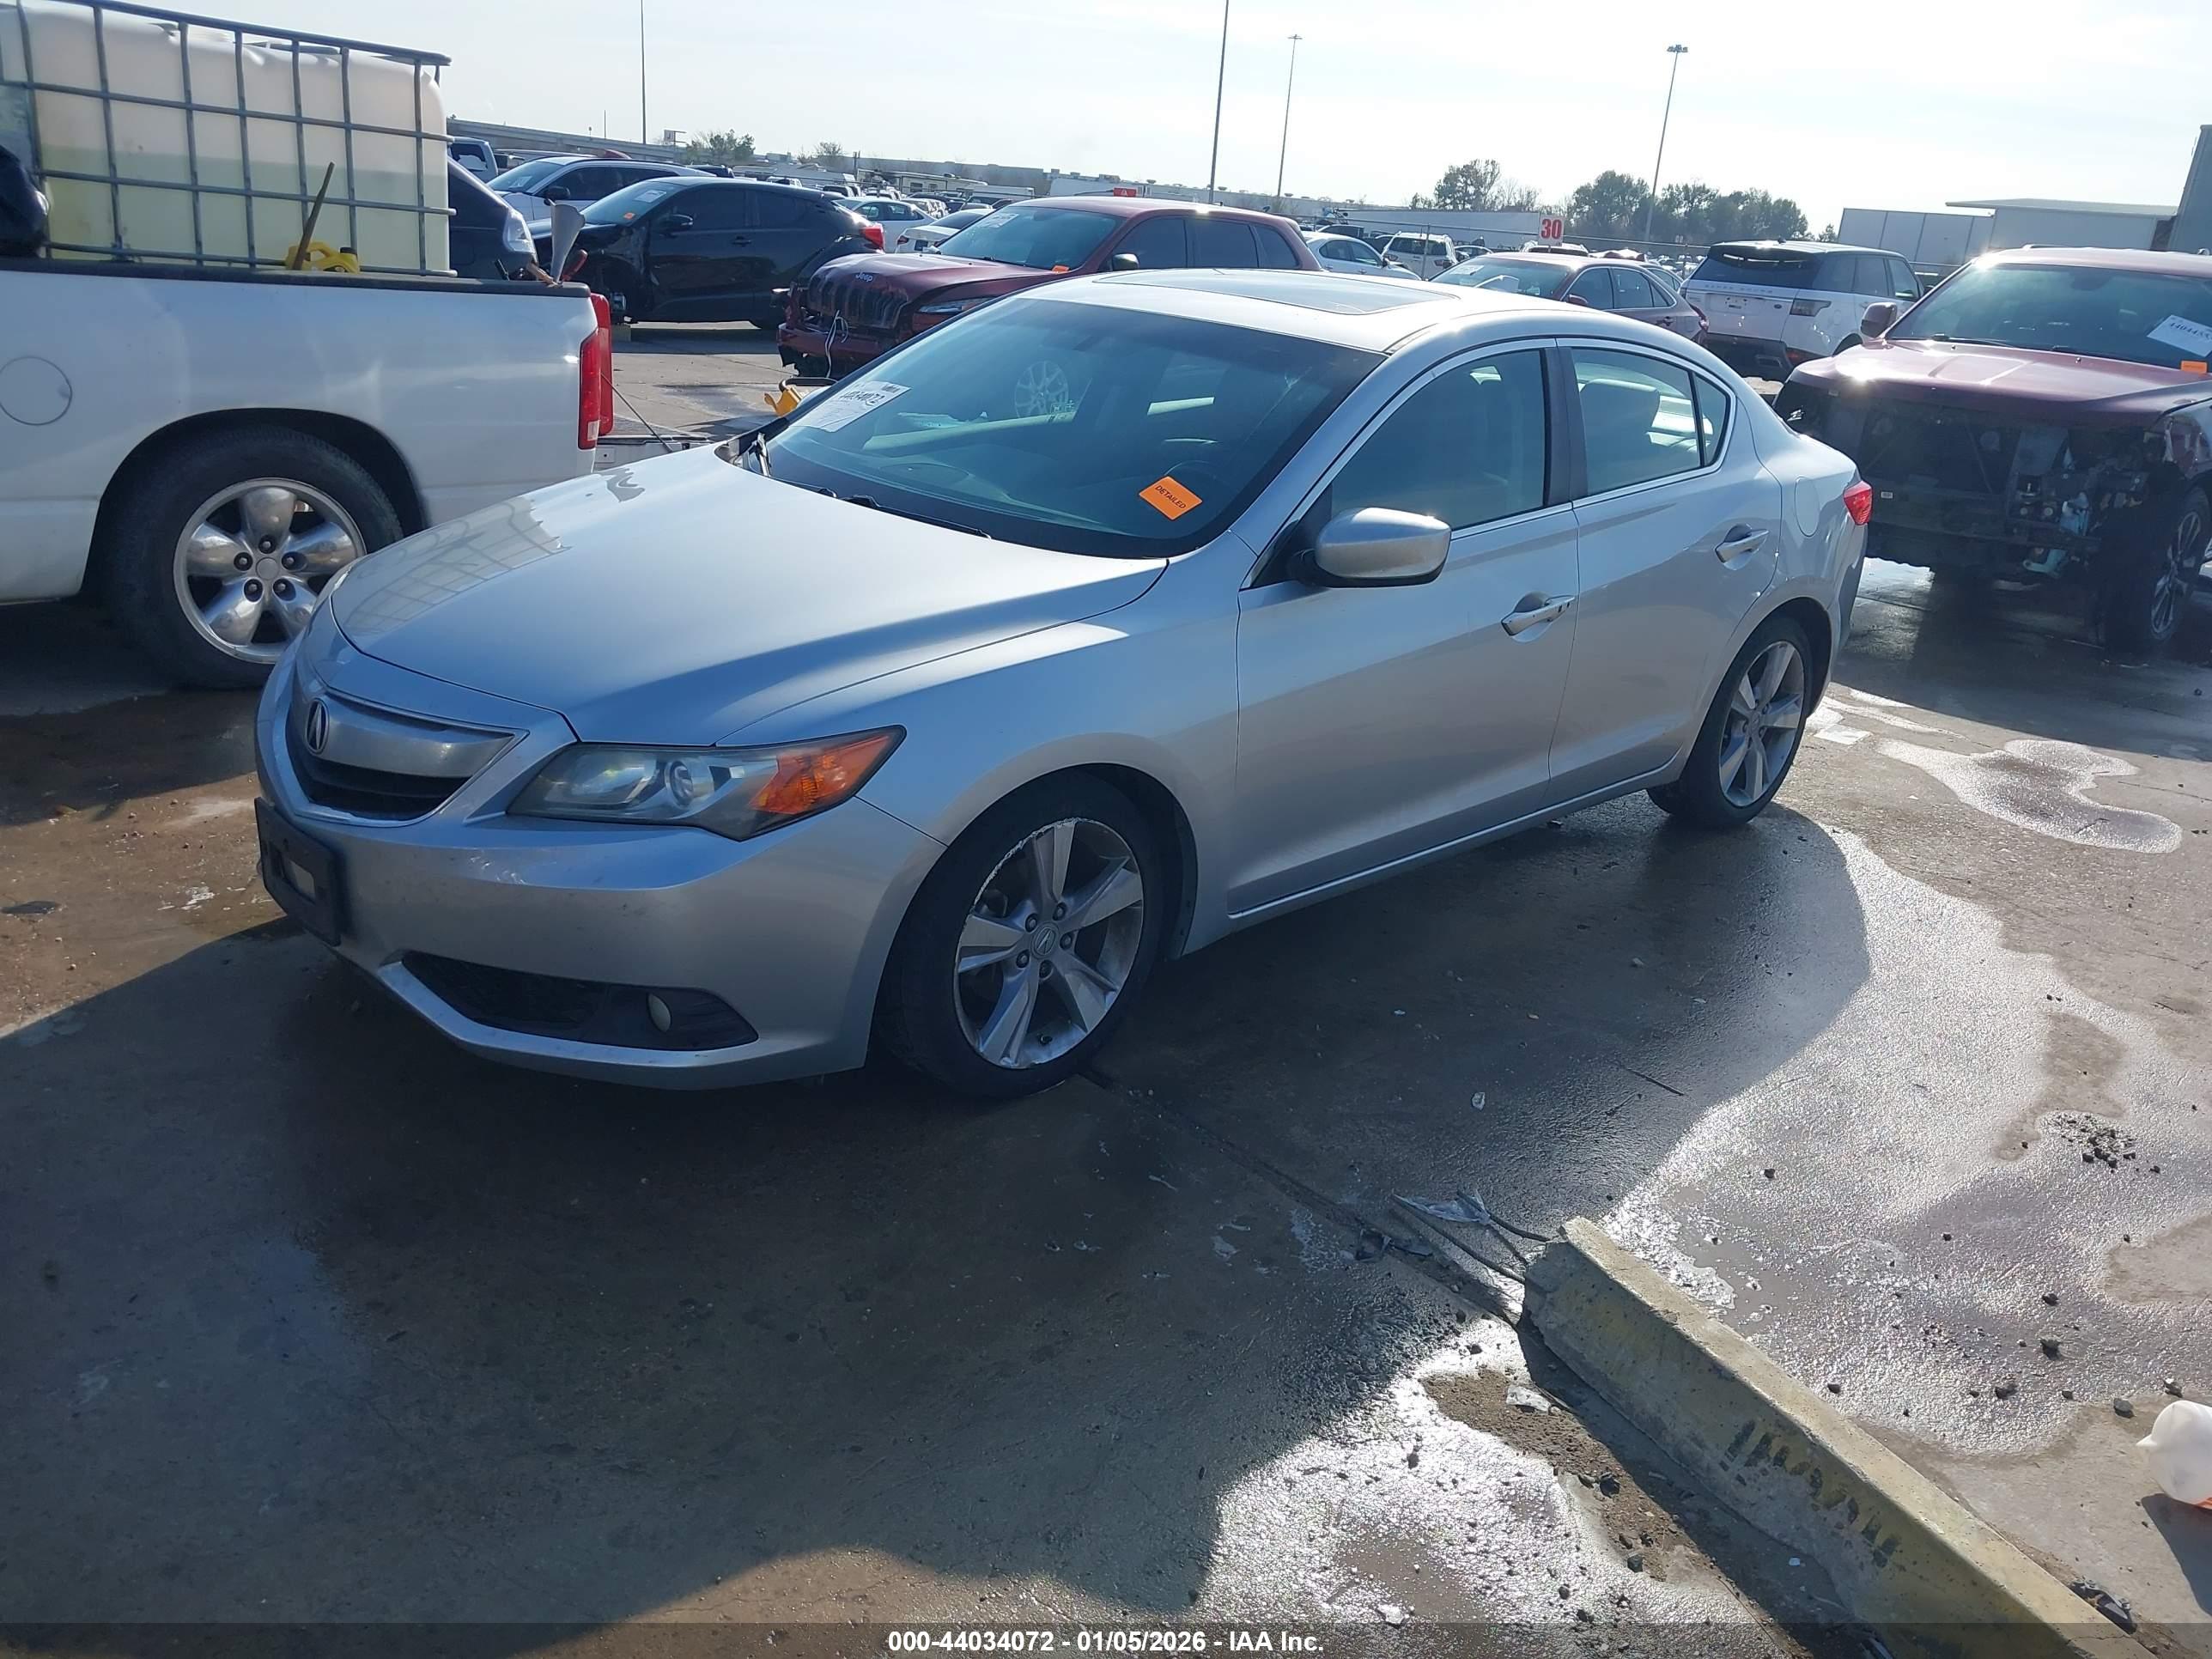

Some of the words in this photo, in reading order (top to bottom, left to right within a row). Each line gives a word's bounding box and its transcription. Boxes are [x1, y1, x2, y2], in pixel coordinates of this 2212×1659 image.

[1541, 218, 1562, 239] 30
[855, 271, 873, 282] Jeep
[1155, 485, 1186, 508] DETAILED
